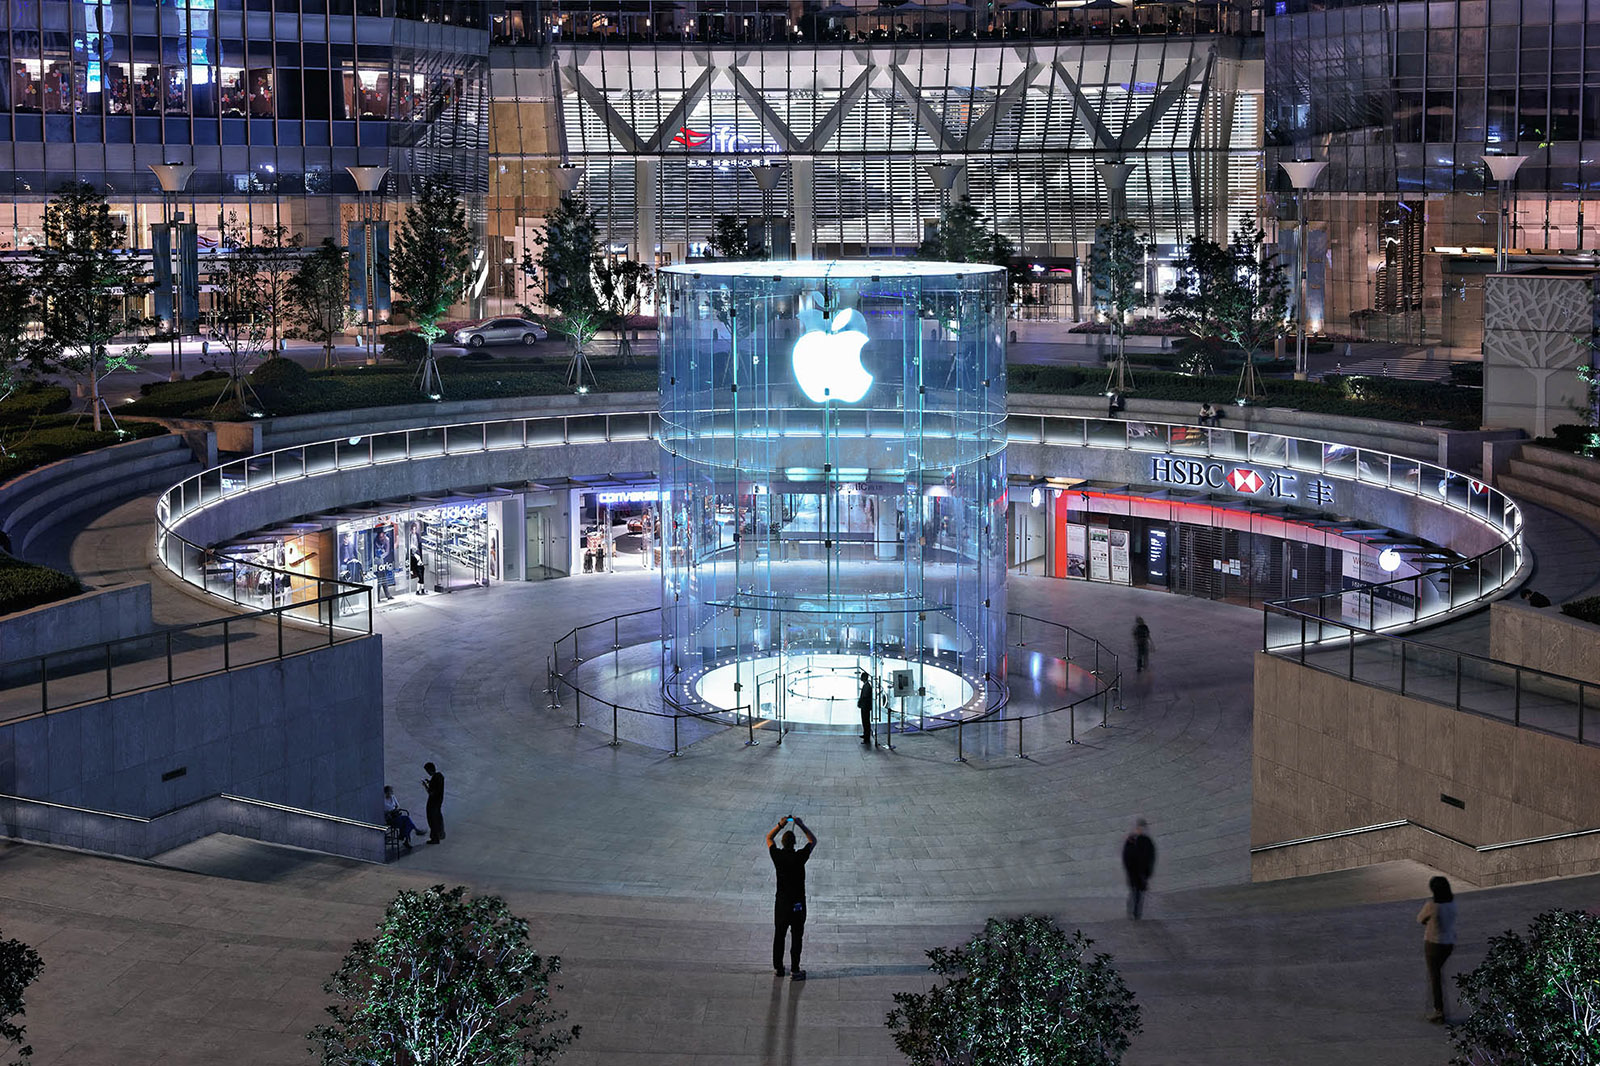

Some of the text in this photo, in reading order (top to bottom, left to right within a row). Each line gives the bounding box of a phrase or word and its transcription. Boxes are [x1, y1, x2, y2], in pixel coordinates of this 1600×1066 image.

[711, 125, 750, 153] ifc
[1151, 457, 1224, 489] HSBC
[441, 504, 483, 519] adidas
